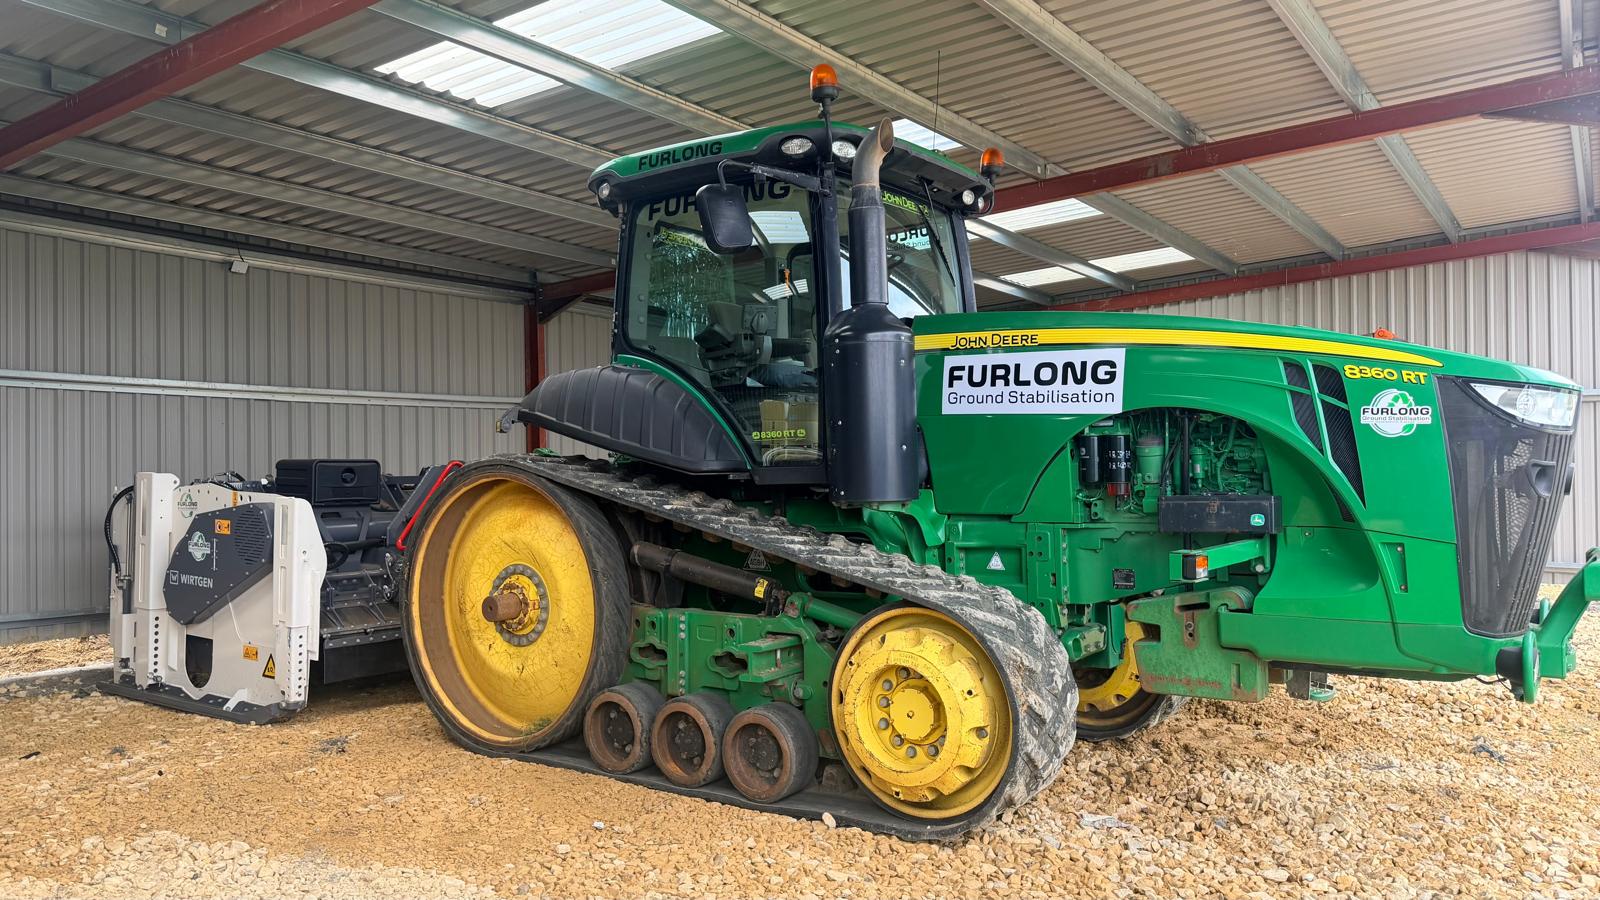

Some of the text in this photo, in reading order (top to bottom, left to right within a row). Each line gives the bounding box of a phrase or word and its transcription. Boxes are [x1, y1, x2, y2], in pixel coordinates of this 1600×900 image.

[638, 141, 723, 171] FURLONG
[648, 179, 791, 221] FURNG
[881, 190, 903, 206] JOHN
[950, 333, 1039, 348] JOHN DEERE
[947, 359, 1117, 389] FURLONG
[1343, 364, 1428, 385] 8360 RT
[947, 389, 1115, 405] Ground Stabilisation
[1362, 407, 1430, 416] FURLONG
[760, 429, 796, 439] 8360 RT
[180, 573, 214, 589] WIRTGEN
